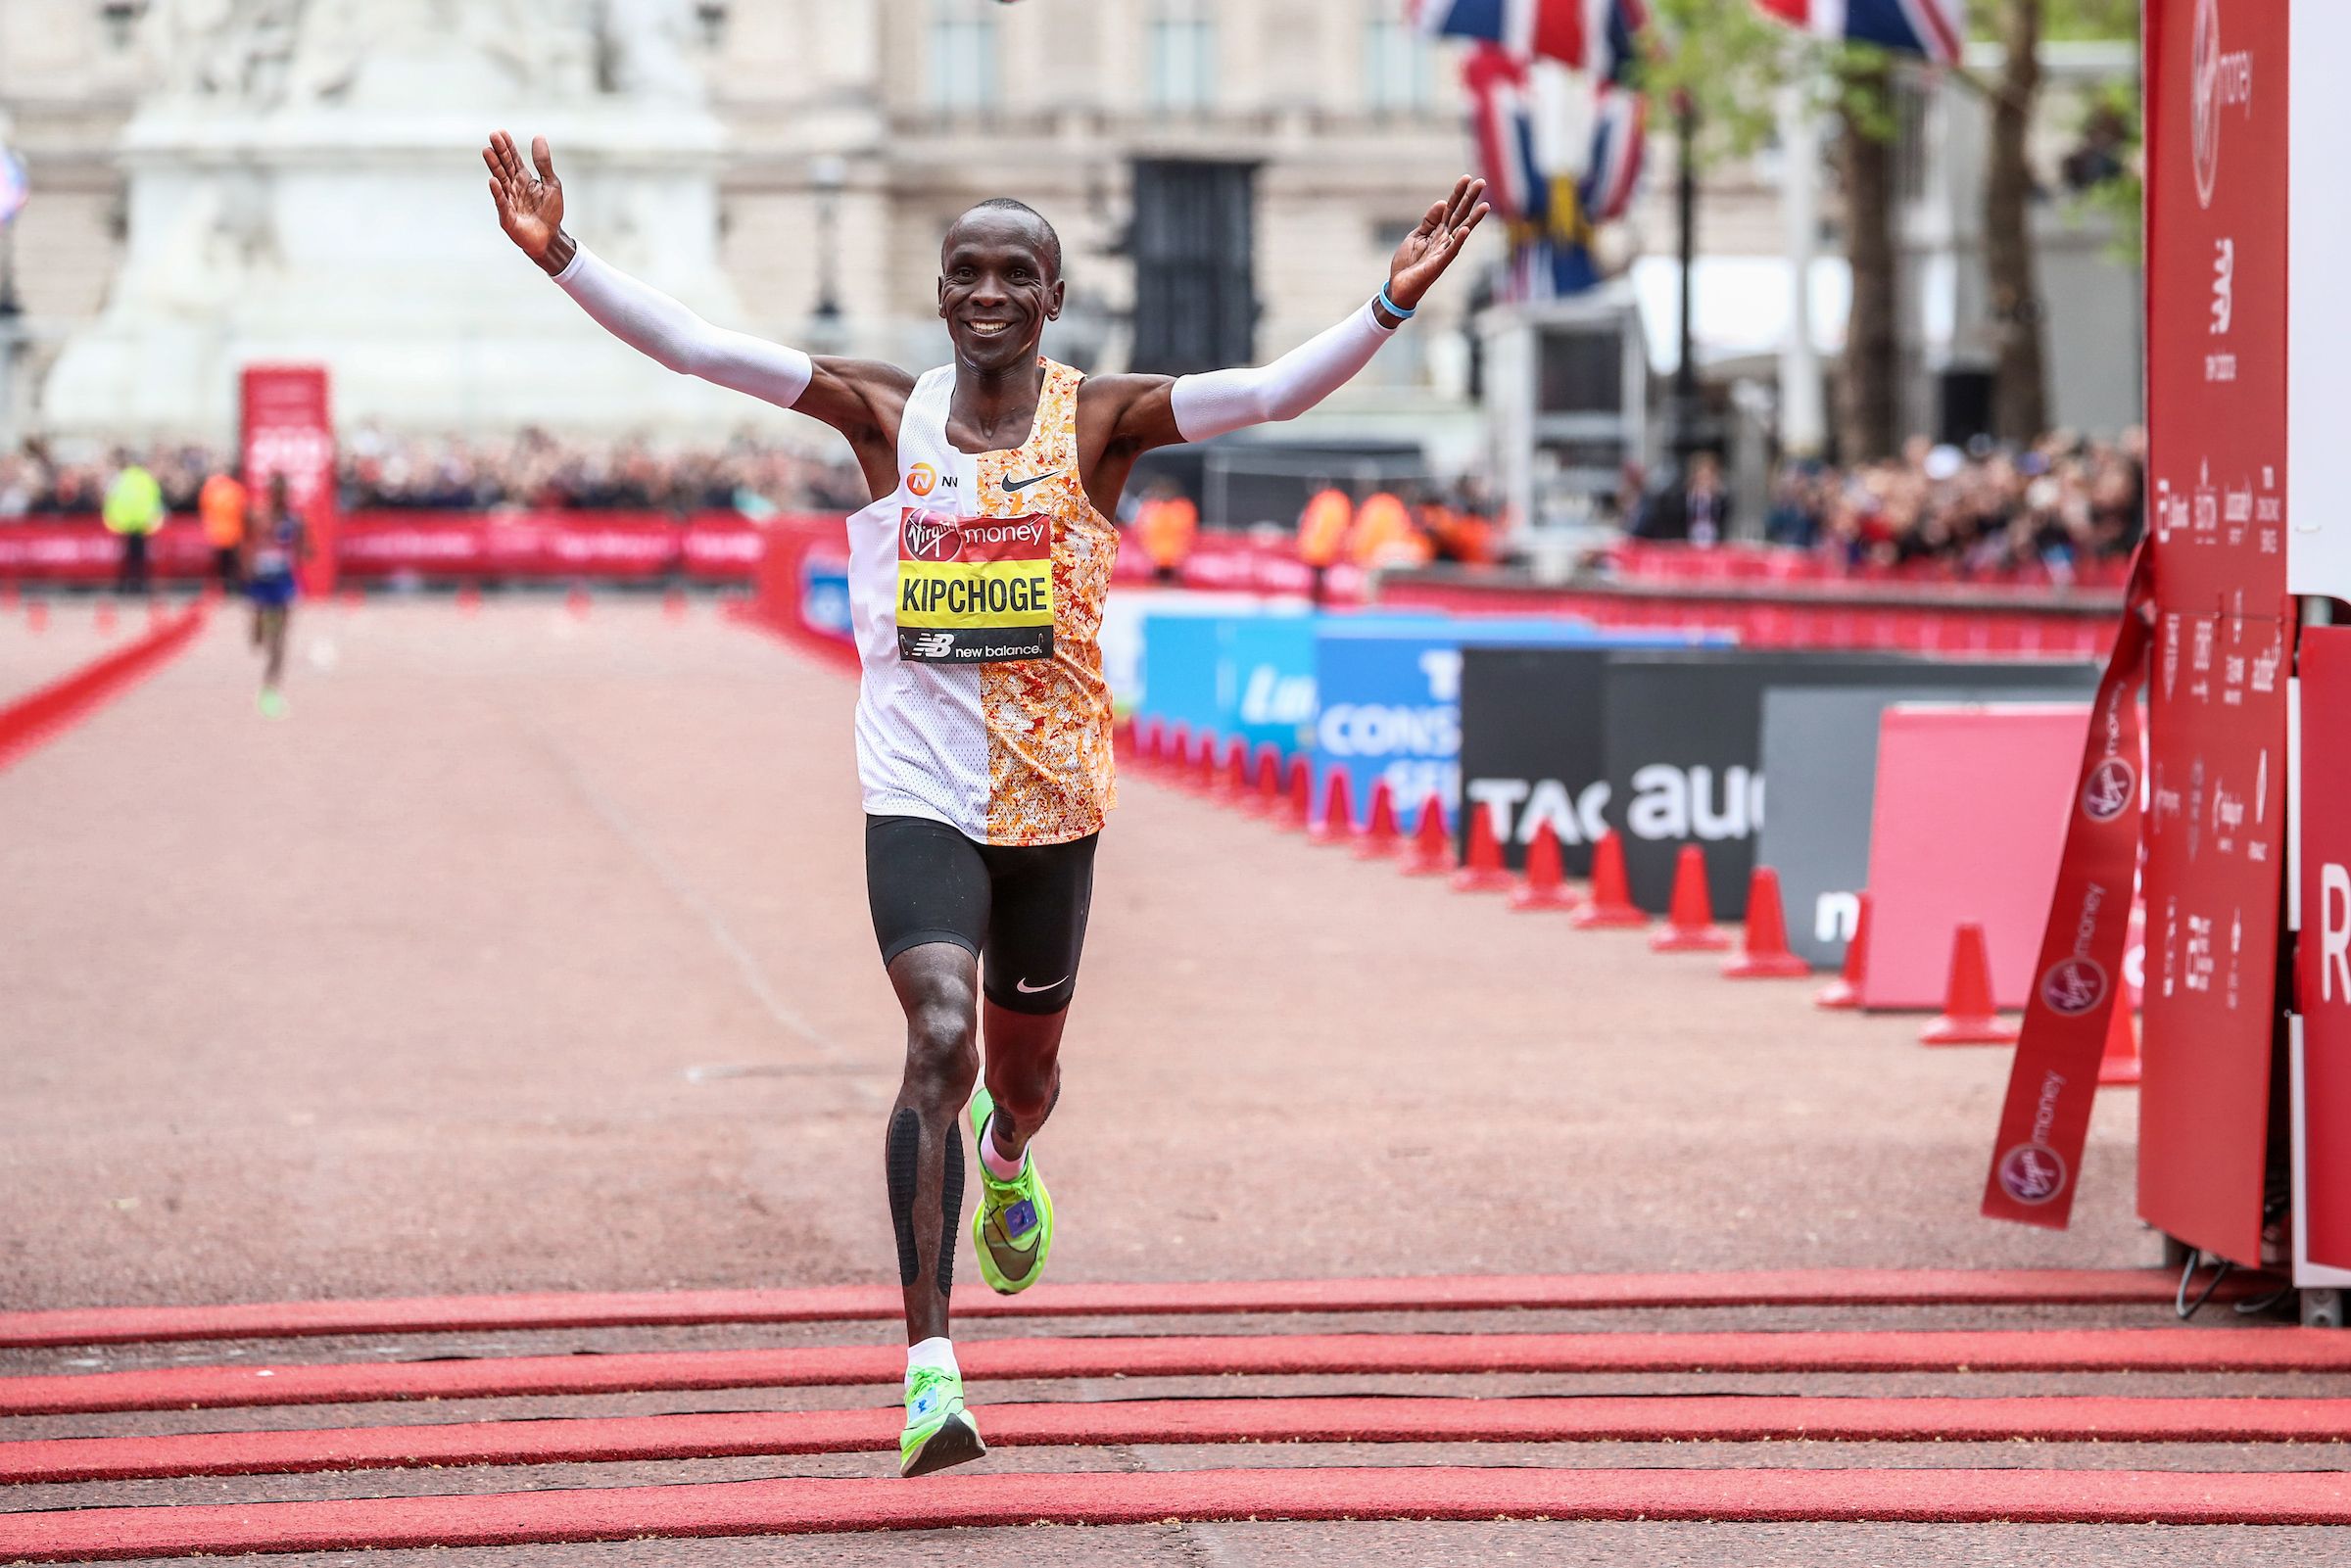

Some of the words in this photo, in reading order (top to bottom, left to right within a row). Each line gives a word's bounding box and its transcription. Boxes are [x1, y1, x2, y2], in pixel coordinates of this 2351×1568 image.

[965, 524, 1043, 546] money
[903, 577, 1047, 612] KIPCHOGE
[955, 646, 984, 658] new
[2074, 882, 2106, 959] money
[2033, 1069, 2067, 1146] money
